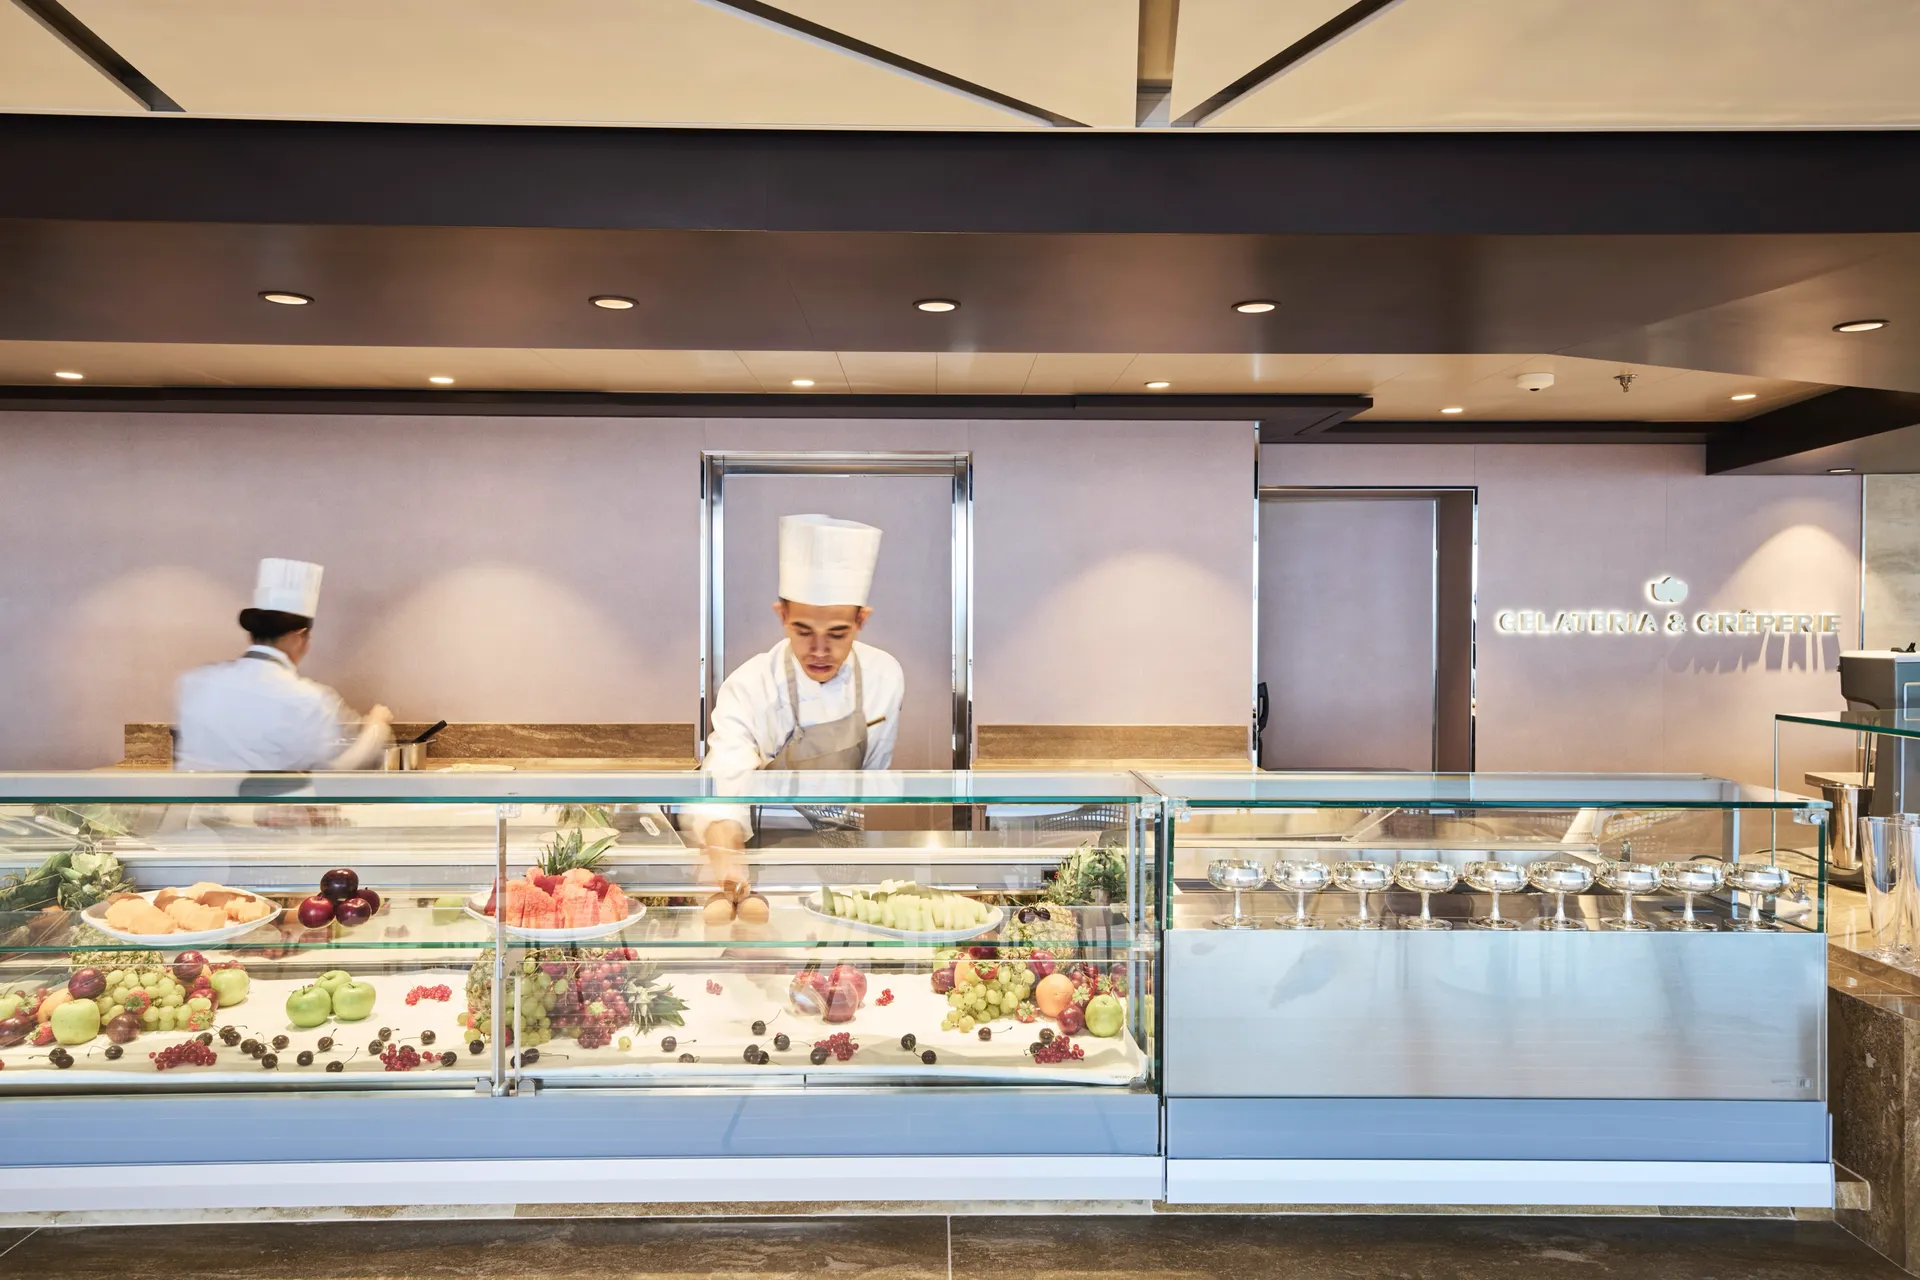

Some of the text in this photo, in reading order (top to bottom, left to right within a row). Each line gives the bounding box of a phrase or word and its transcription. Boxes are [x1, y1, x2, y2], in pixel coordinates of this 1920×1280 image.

[1498, 609, 1841, 633] GELATERIA & CRÊPERIE
